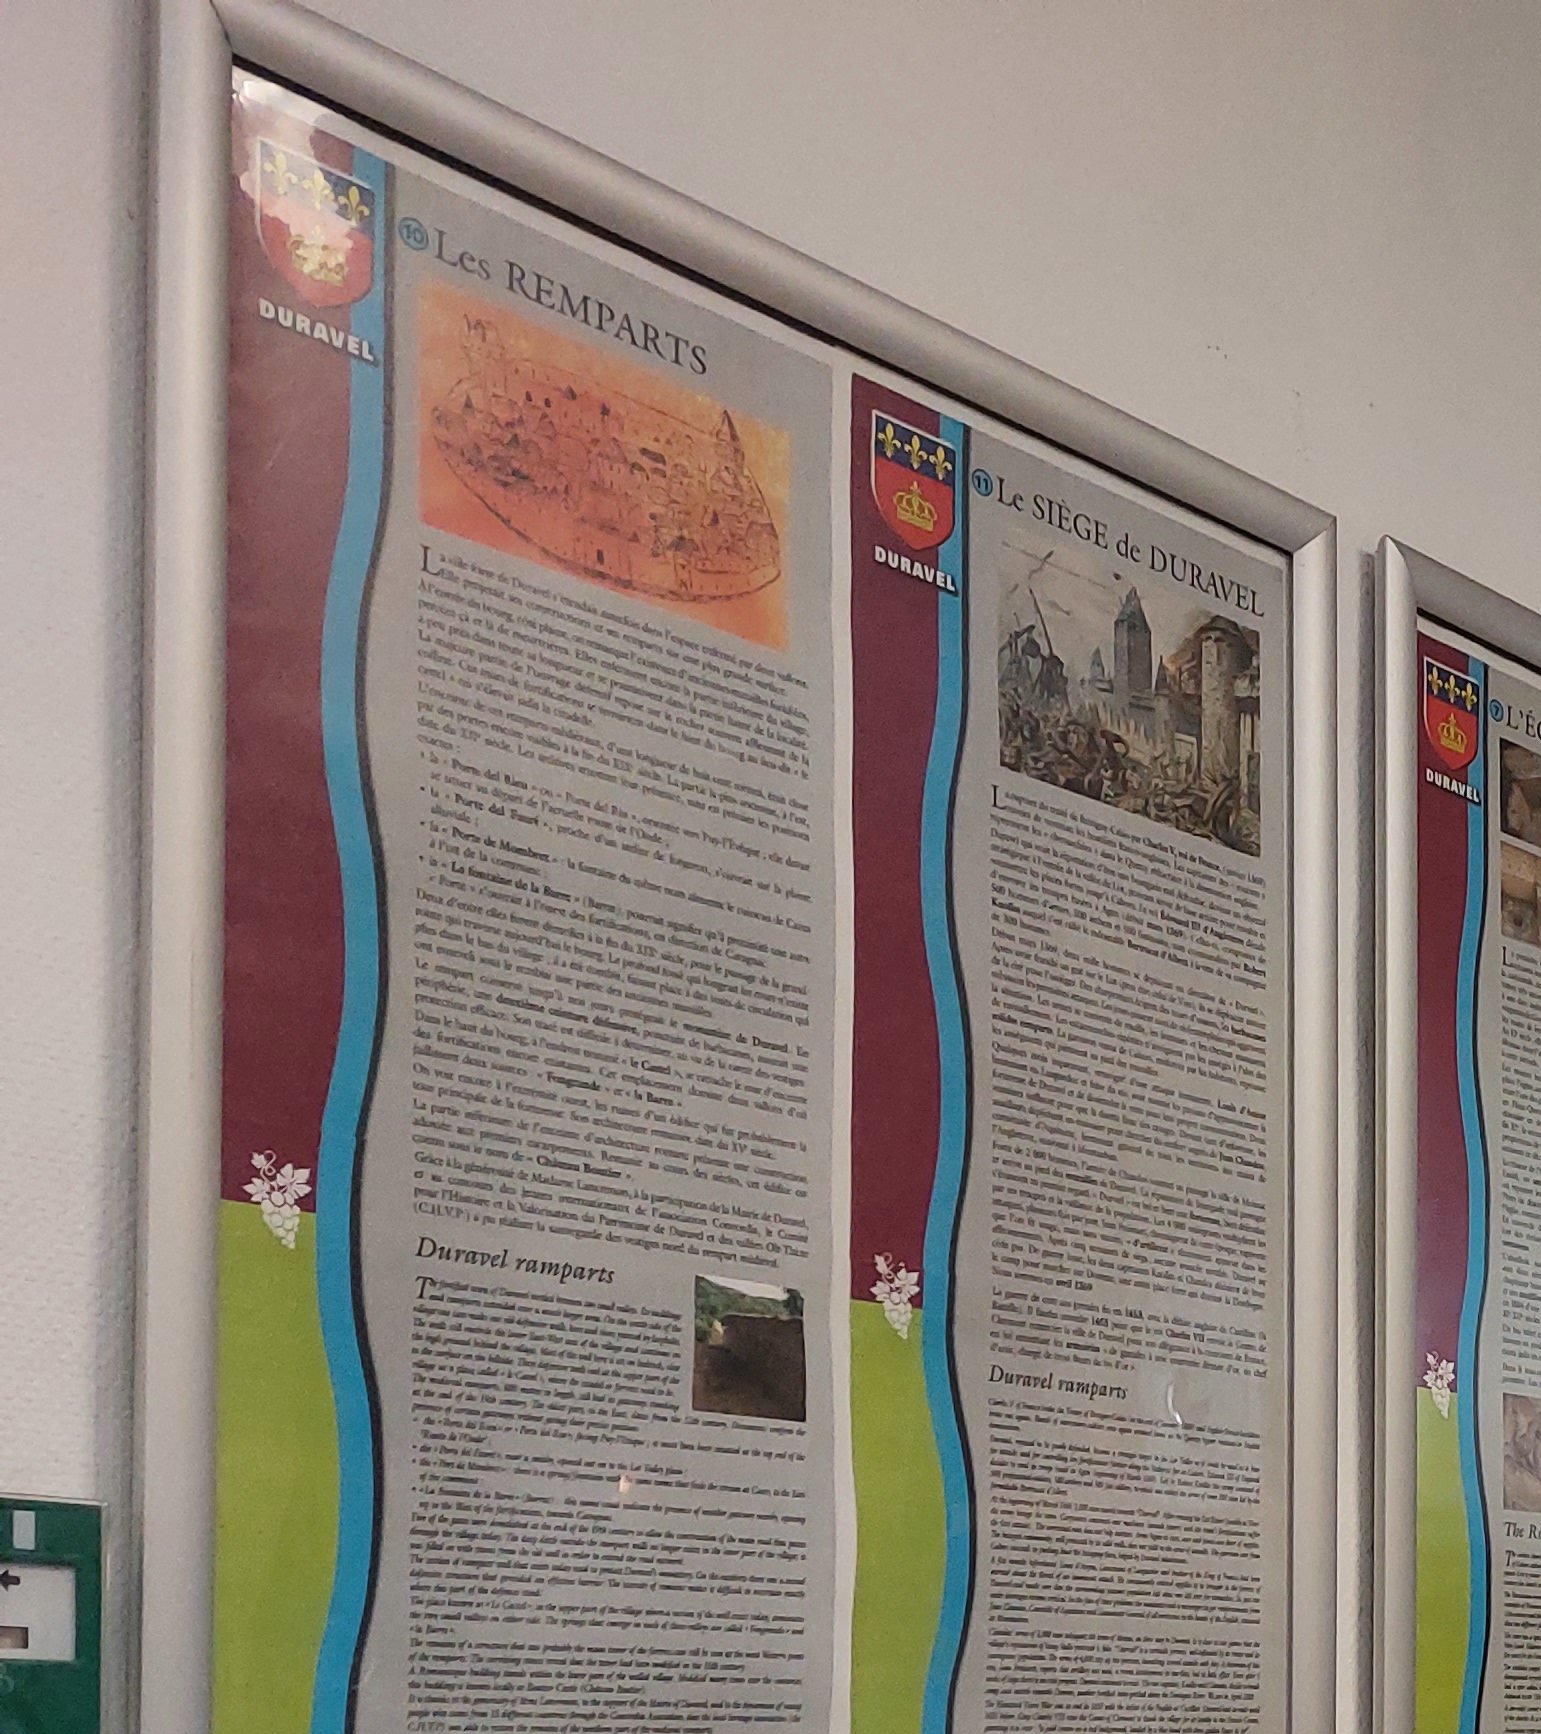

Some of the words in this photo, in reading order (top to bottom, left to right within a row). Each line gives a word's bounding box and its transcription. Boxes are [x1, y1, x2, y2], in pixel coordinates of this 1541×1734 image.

[434, 228, 491, 281] Les
[505, 260, 708, 375] REMPARTS
[258, 297, 375, 362] DURAVEL
[874, 545, 957, 592] DURAVEL
[996, 476, 1024, 512] Le
[1032, 494, 1108, 550] SIÈGE
[1116, 533, 1141, 563] de
[1149, 546, 1265, 617] DURAVEL
[1425, 768, 1480, 803] DURAVEL
[416, 1236, 508, 1269] Duravel
[515, 1255, 615, 1284] ramparts
[988, 1364, 1052, 1390] Duravel
[1058, 1380, 1129, 1400] ramparts
[1504, 1522, 1524, 1539] The
